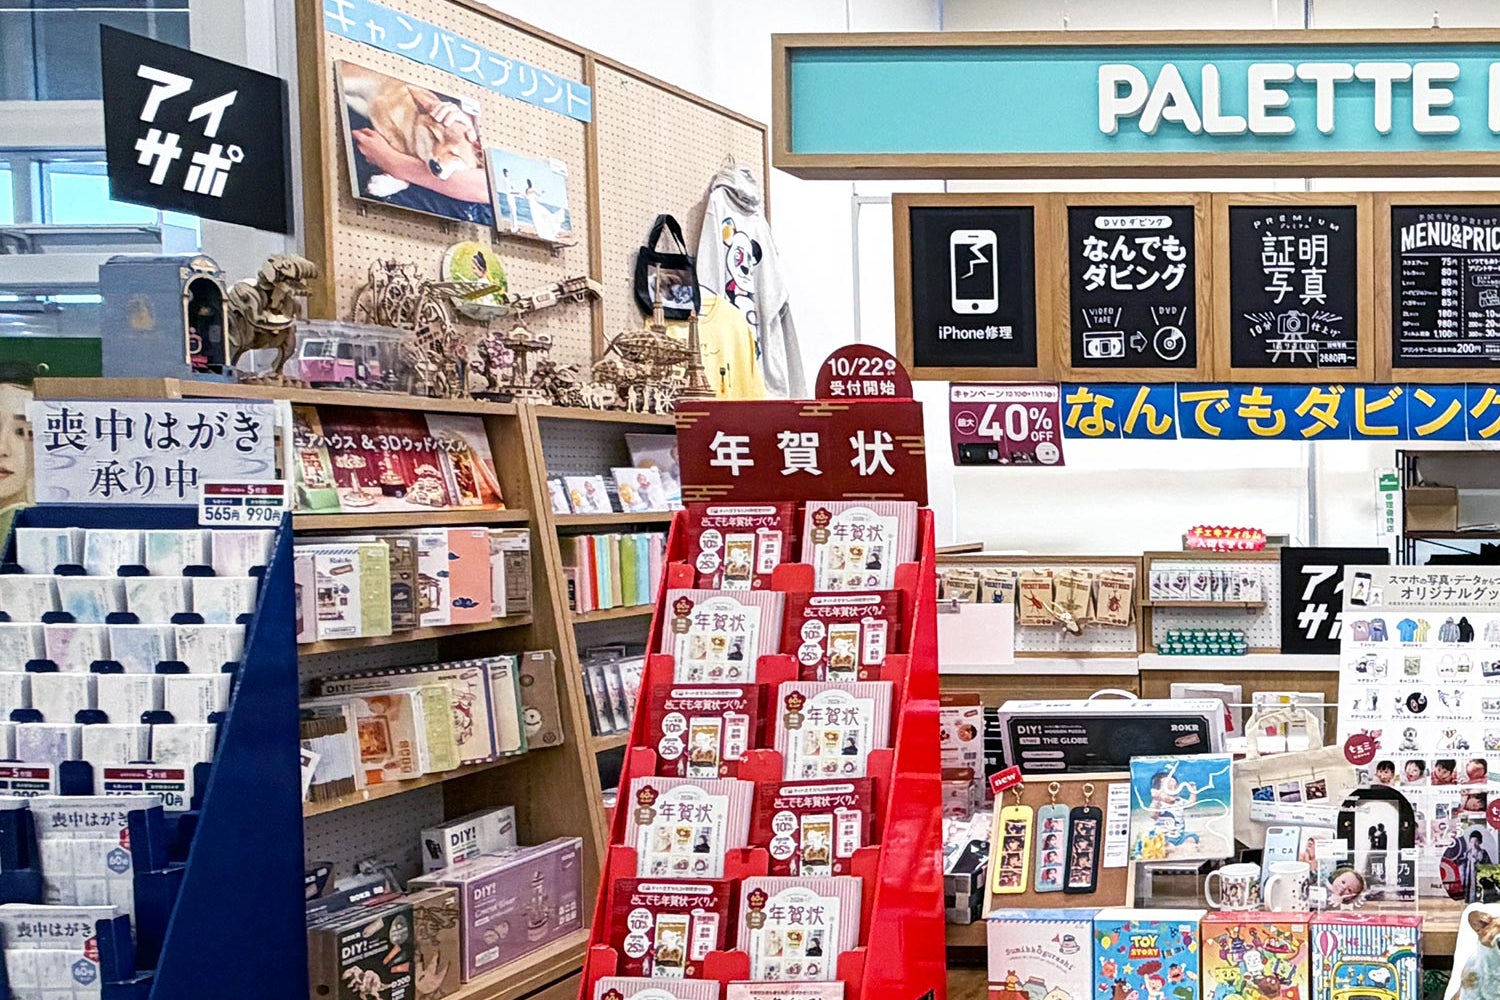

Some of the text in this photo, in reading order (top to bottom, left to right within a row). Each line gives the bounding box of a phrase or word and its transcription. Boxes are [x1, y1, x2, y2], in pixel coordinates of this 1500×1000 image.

[326, 0, 589, 110] キャンバスプリント
[135, 64, 238, 138] アイ
[1098, 62, 1462, 135] PALETTE
[133, 129, 245, 198] サポ
[1253, 214, 1340, 232] PREMIUM
[1082, 234, 1188, 262] なんでも
[1262, 231, 1328, 266] 証明
[1081, 264, 1188, 292] ダビング
[1263, 267, 1327, 305] 写真
[1089, 306, 1178, 316] VIDEO DVD
[1093, 315, 1113, 324] TAPE
[938, 325, 1014, 341] iPhone修理
[828, 357, 885, 377] 10/22
[830, 381, 896, 396] 受付開始
[953, 389, 1005, 399] キャンペーン
[44, 407, 261, 452] 喪中はがき
[978, 403, 1053, 441] 40%
[361, 436, 375, 451] &
[1030, 431, 1054, 442] OFF
[709, 430, 896, 476] 年賀状
[90, 458, 198, 498] 承り中
[205, 507, 280, 521] 565円 990円
[832, 522, 884, 543] 年賀状
[694, 610, 746, 633] 年賀状
[807, 706, 860, 726] 年賀状
[1017, 724, 1200, 734] DIY! ROKR
[1042, 737, 1089, 745] THE GLOBE
[994, 772, 1017, 787] new
[51, 811, 129, 828] 喪中はがき
[659, 802, 713, 823] 年賀状
[450, 826, 477, 847] DIY!
[473, 883, 497, 901] DIY!
[768, 905, 824, 926] 年賀状
[17, 922, 93, 938] 喪中はがき
[341, 940, 368, 959] DIY!
[1131, 934, 1159, 948] TOY
[1130, 949, 1159, 957] STORY
